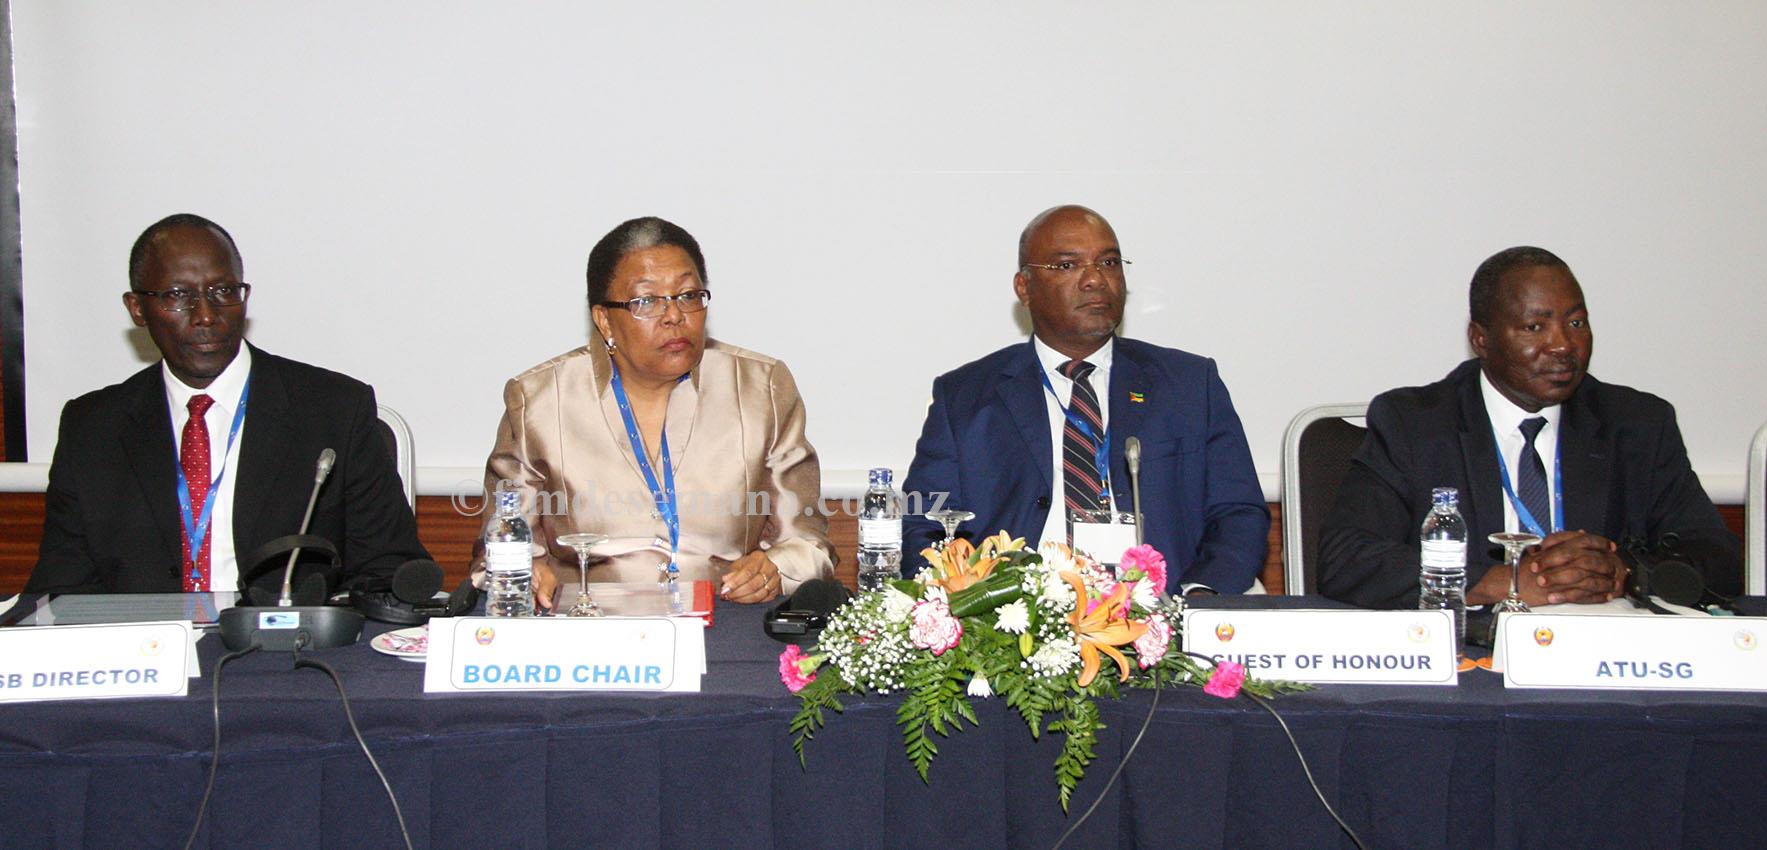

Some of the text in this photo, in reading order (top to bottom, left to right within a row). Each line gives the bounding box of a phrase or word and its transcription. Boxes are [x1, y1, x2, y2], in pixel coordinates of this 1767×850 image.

[1295, 654, 1323, 669] OF
[1333, 654, 1432, 670] HONOUR
[1596, 661, 1693, 679] ATU-SG
[32, 669, 158, 687] DIRECTOR
[463, 664, 661, 684] BOARD CHAIR
